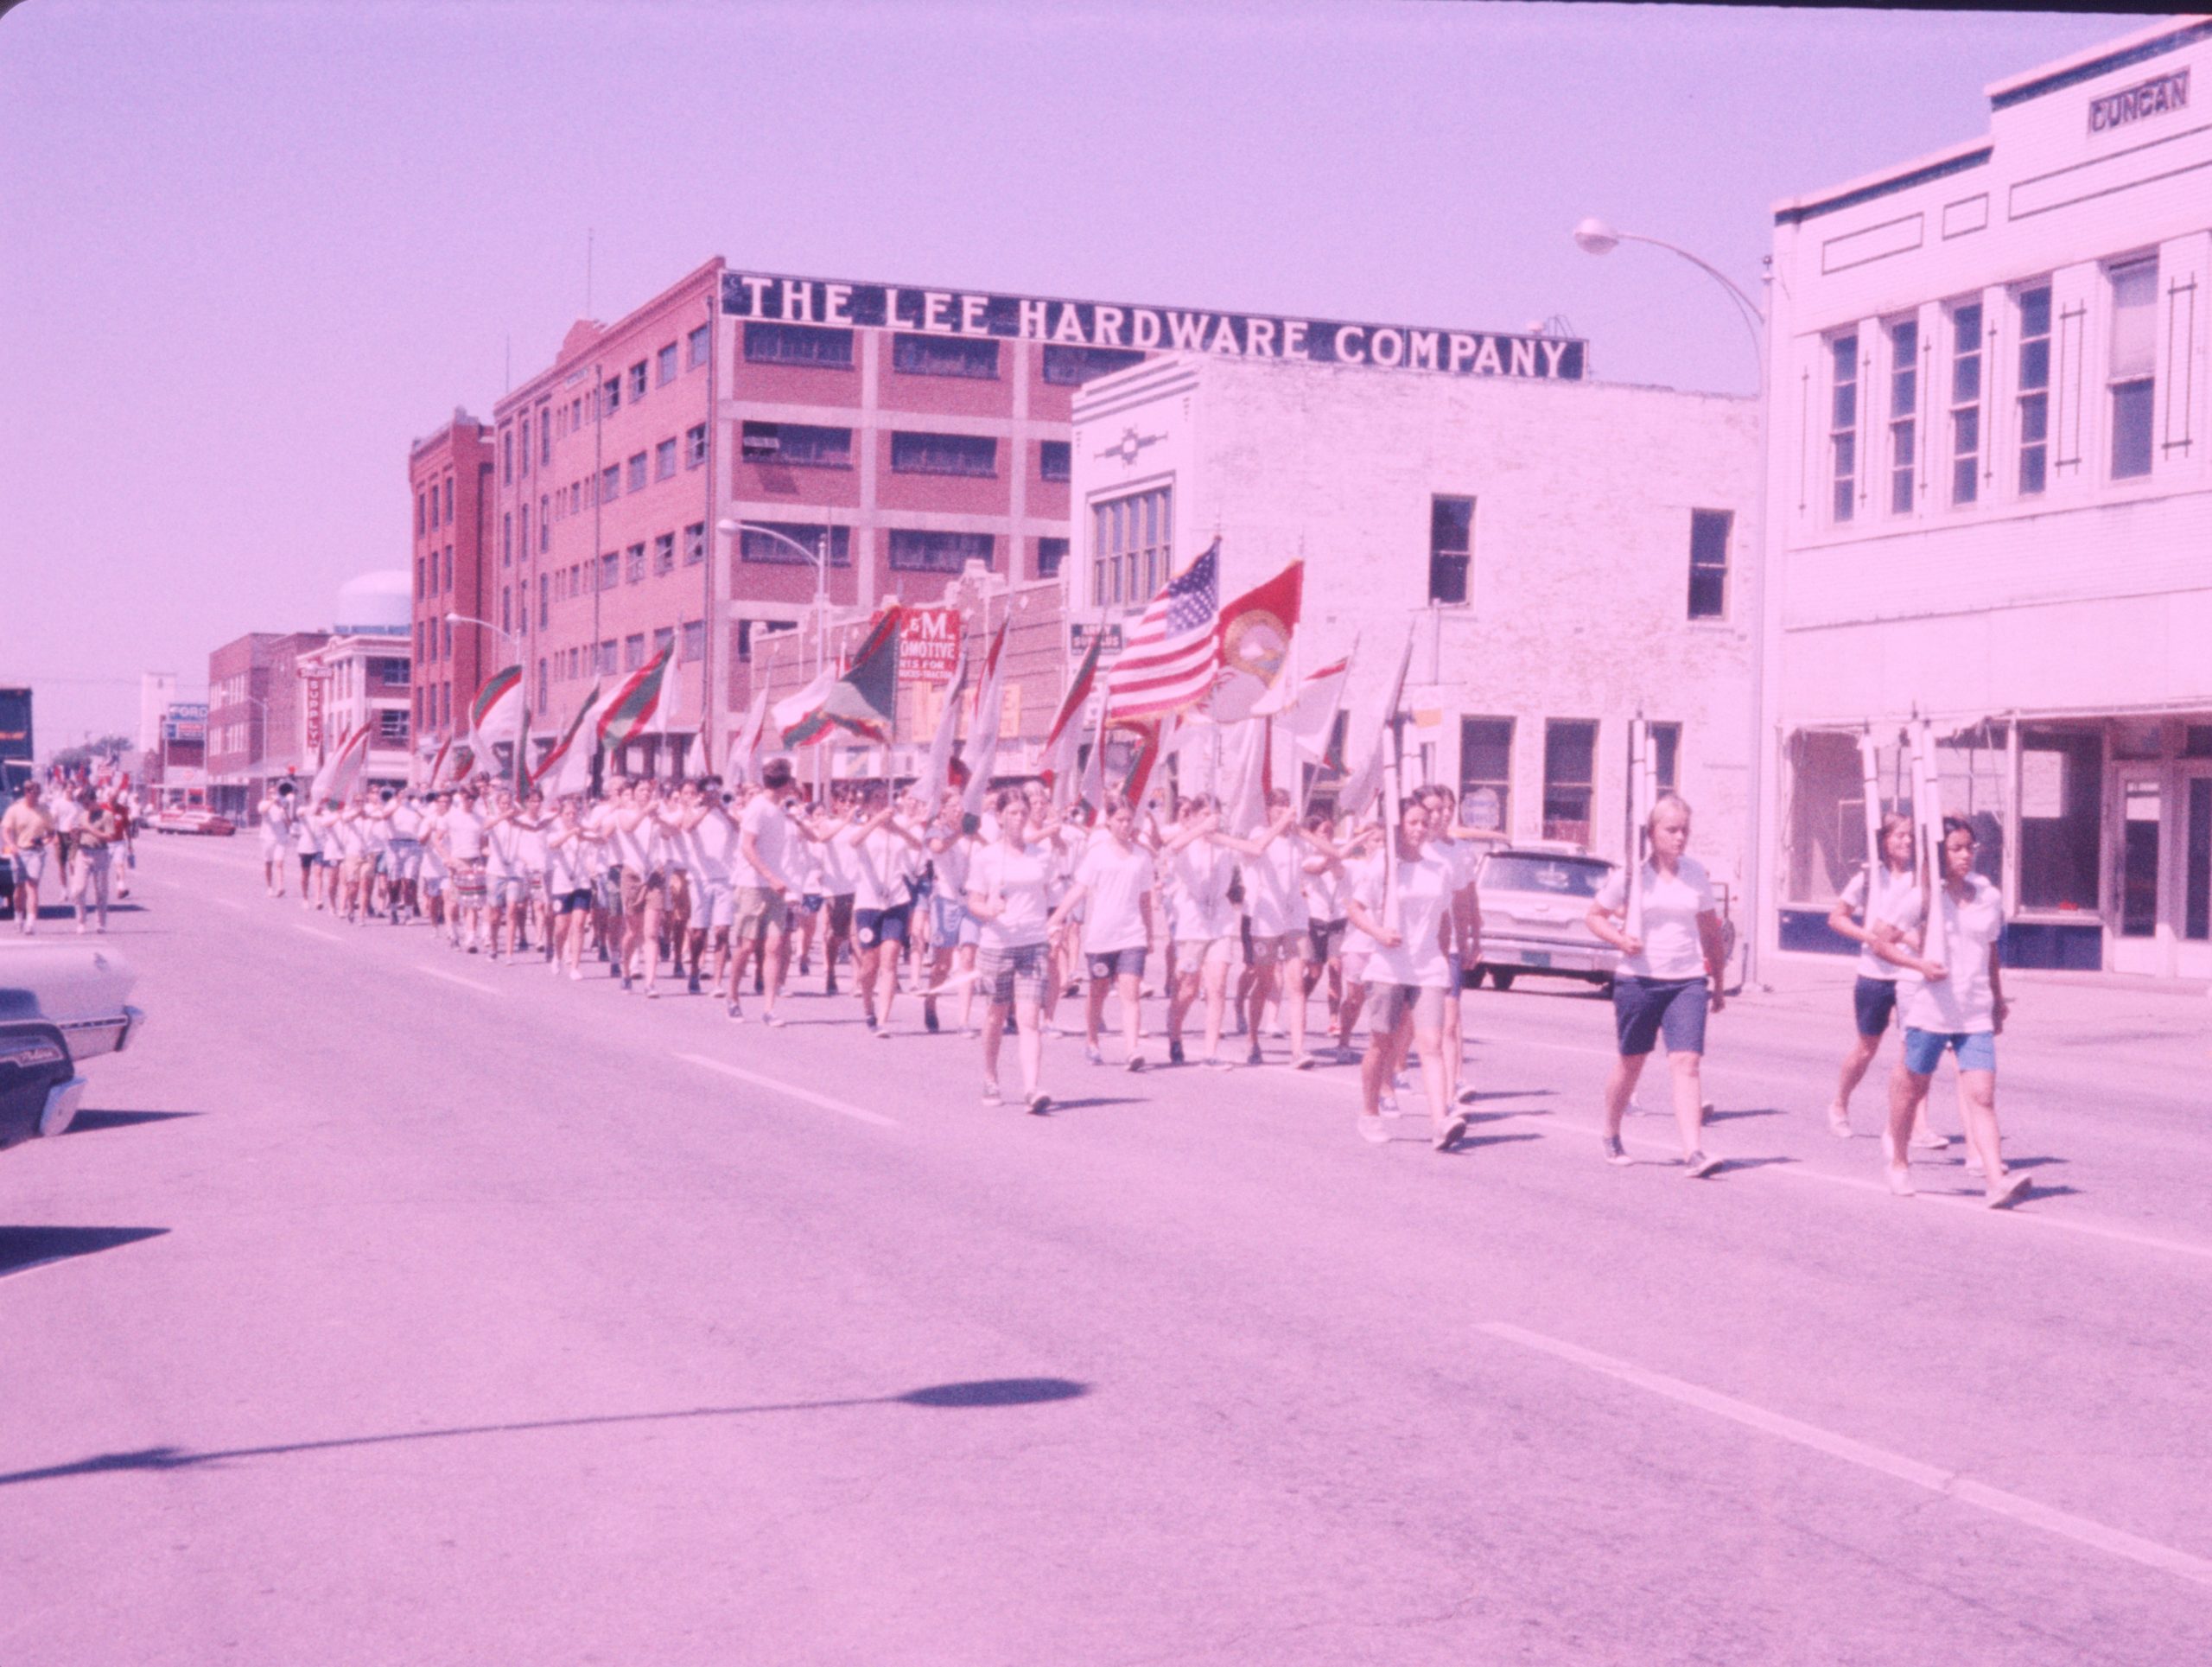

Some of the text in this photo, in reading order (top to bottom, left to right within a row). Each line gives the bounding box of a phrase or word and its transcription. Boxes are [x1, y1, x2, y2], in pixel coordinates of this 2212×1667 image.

[2091, 77, 2188, 132] DUNCAN
[741, 277, 1567, 379] THE LEE HARDWARE COMPANY
[900, 640, 955, 659] OMOTIVE
[1074, 636, 1118, 646] SULUS
[899, 659, 919, 668] RTS
